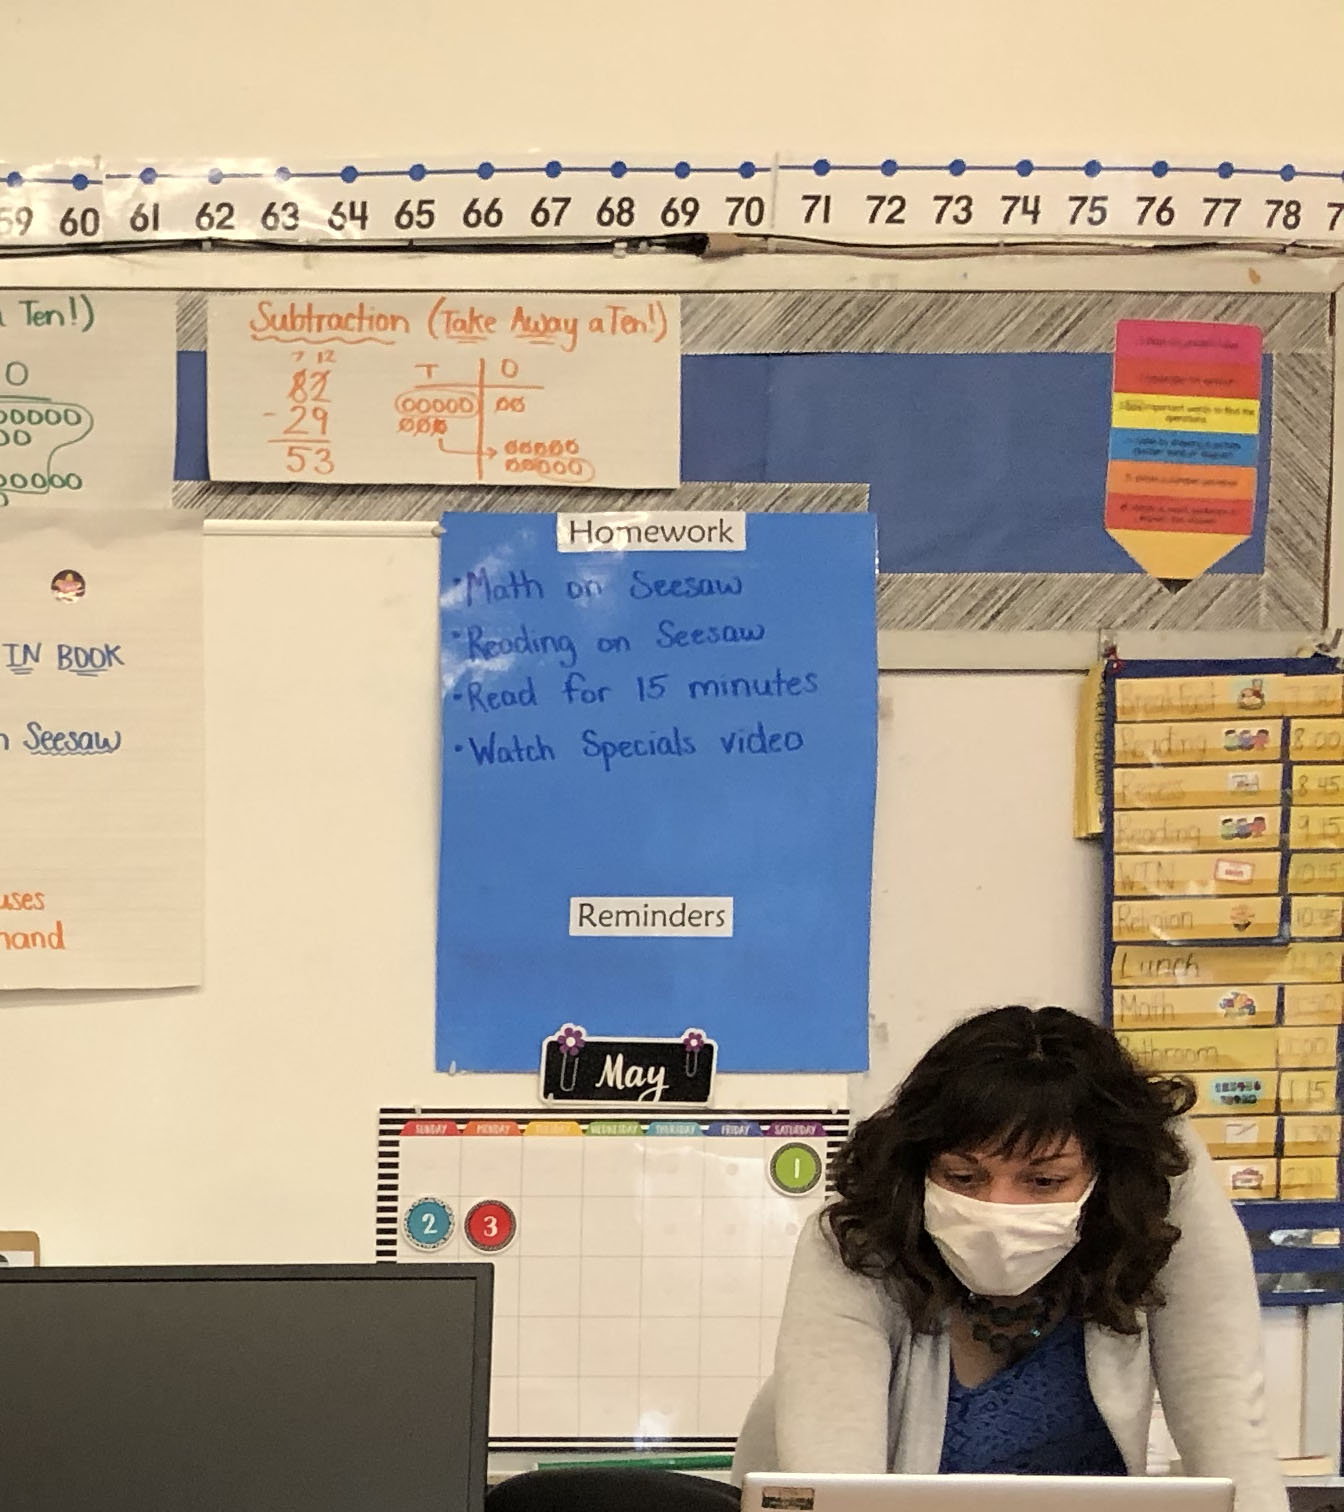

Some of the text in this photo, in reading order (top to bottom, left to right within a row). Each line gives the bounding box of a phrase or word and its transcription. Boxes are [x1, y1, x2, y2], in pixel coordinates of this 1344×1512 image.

[60, 207, 99, 236] 60
[462, 198, 503, 228] 66
[597, 198, 635, 227] 68
[866, 196, 905, 224] 72
[1136, 197, 1175, 226] 76
[18, 294, 95, 332] Ten!)
[250, 301, 410, 335] Subtraction
[428, 297, 497, 339] (Take
[511, 302, 577, 351] Away
[415, 364, 439, 378] T
[282, 406, 329, 436] 29
[286, 446, 335, 475] 53
[569, 520, 734, 544] Homework
[466, 567, 743, 606] Math on Seesaw
[2, 642, 41, 668] IN
[57, 643, 126, 671] BOOK
[467, 620, 766, 667] Reading on Seesaw
[468, 668, 819, 713] Read for 15 minutes
[24, 722, 122, 753] Seesaw
[469, 722, 803, 771] Watch Specials video
[578, 903, 726, 928] Reminders
[1120, 953, 1199, 979] Lunch
[595, 1053, 669, 1103] May
[415, 1124, 815, 1135] SUNDAY MONDAY FRIDAY SATURDAY
[793, 1158, 801, 1178] 1
[422, 1213, 497, 1237] 2 3
